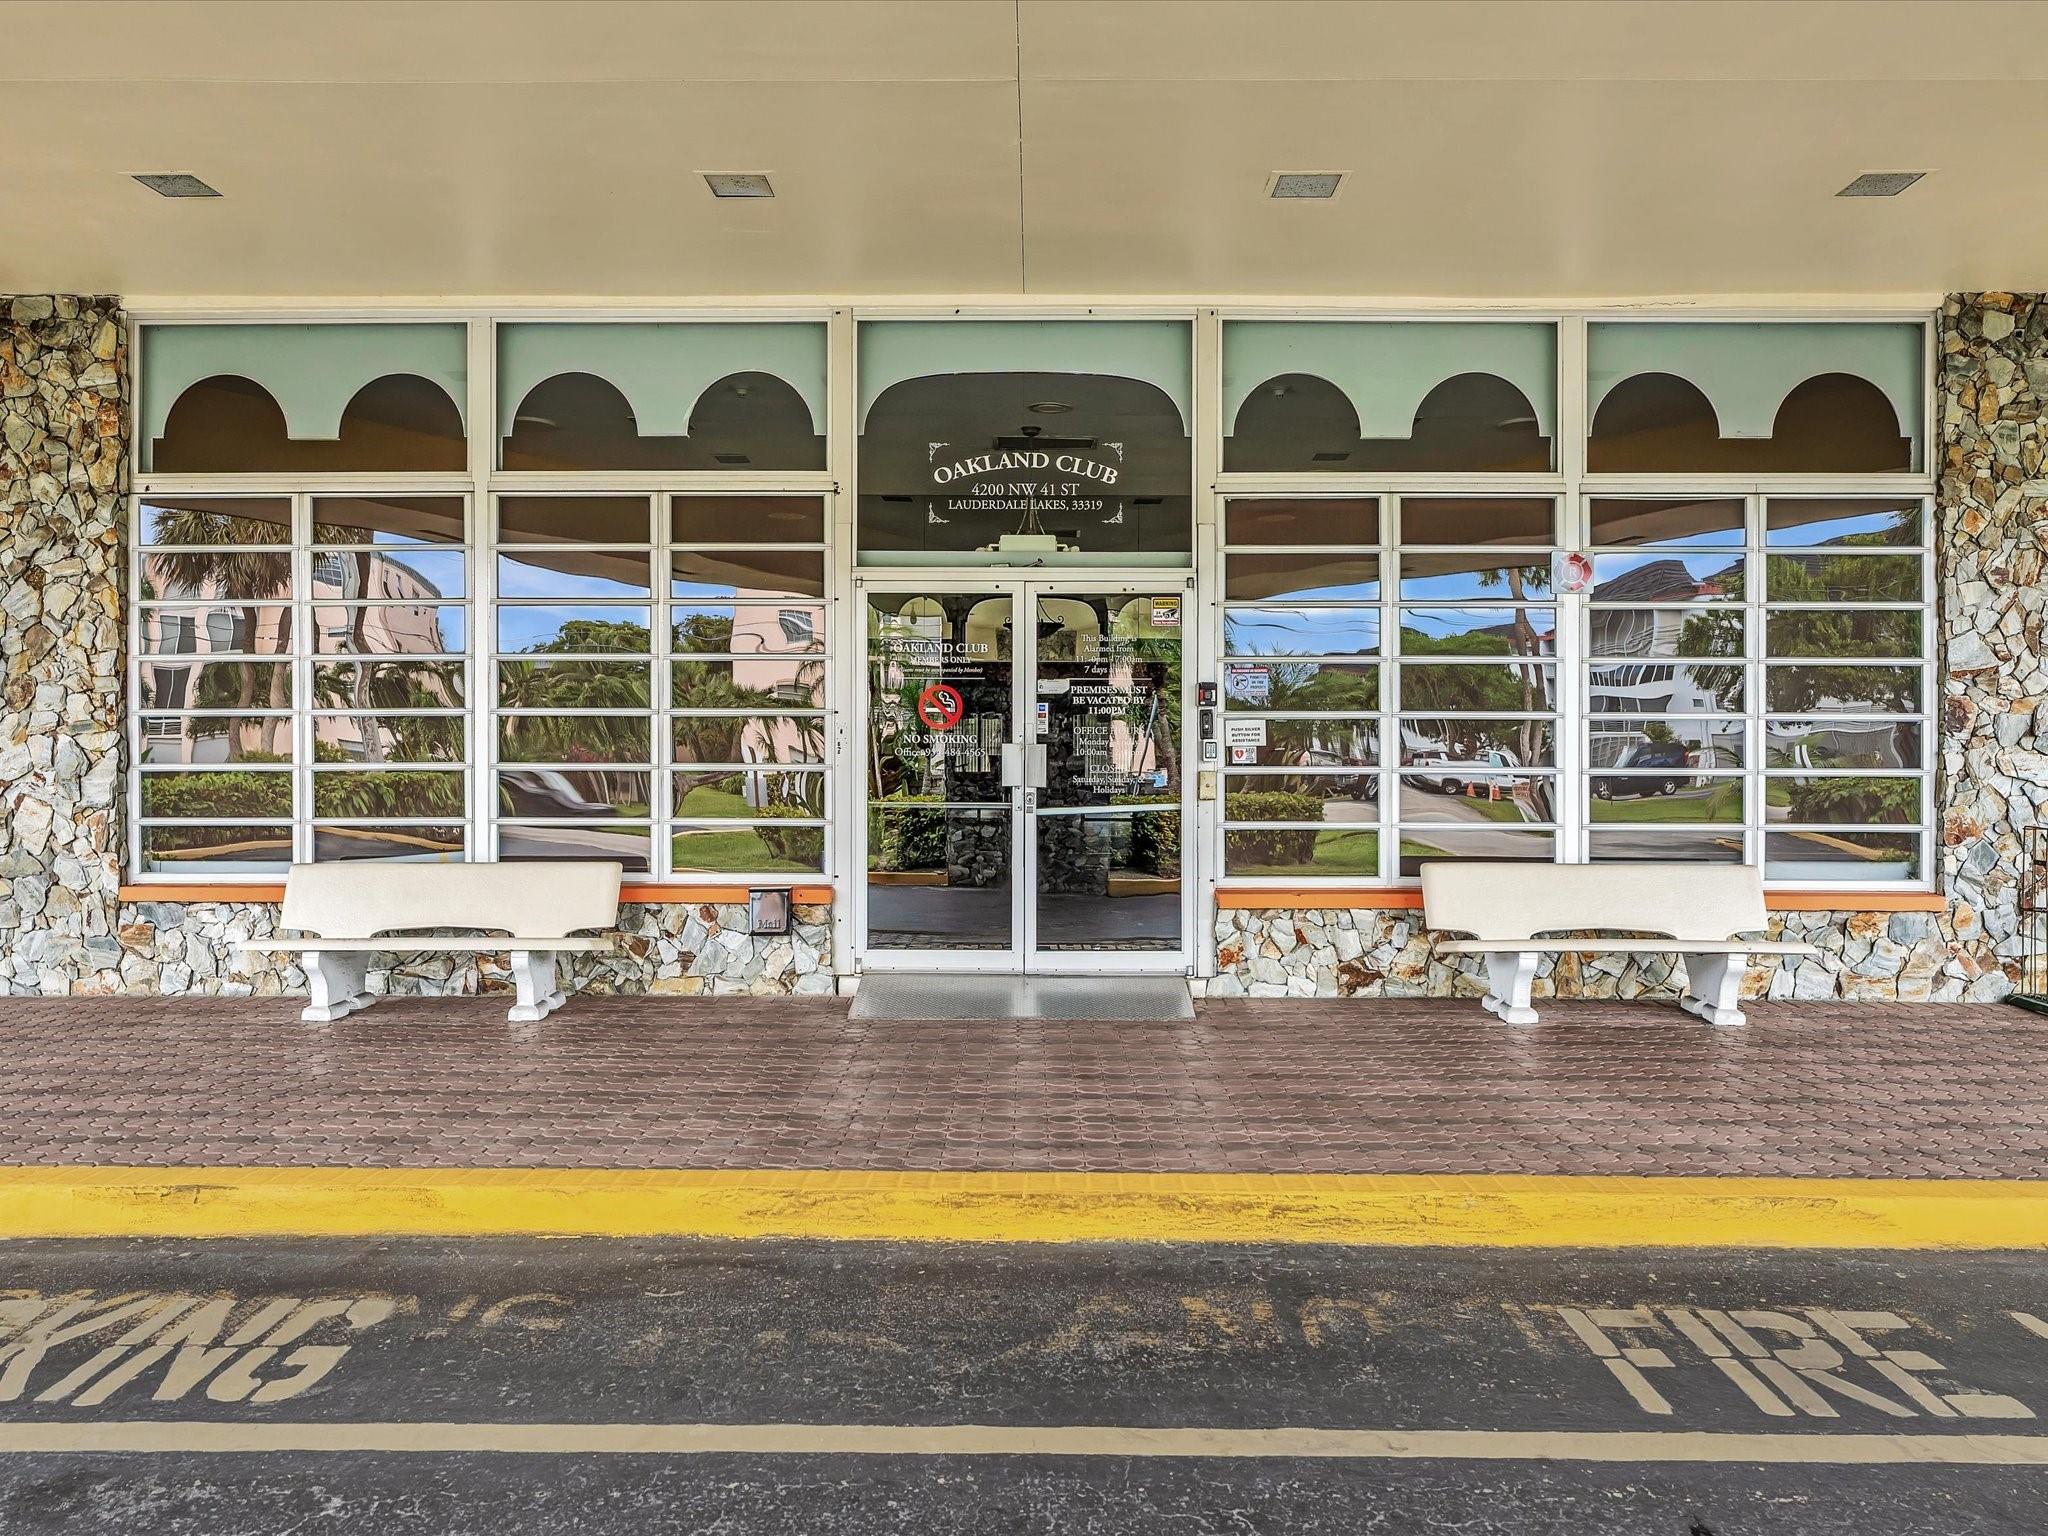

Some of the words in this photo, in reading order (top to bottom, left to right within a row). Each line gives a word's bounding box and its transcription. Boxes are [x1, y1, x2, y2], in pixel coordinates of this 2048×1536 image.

[933, 451, 1050, 484] OAKLAND
[1055, 455, 1119, 485] CLUB
[971, 482, 1004, 496] 4200
[1008, 482, 1037, 496] NW
[1040, 482, 1055, 496] 41
[1060, 482, 1080, 496] ST
[948, 499, 1027, 511] LAUDERDALE
[1030, 499, 1069, 512] LAKES,
[1071, 499, 1103, 511] 33319
[1081, 634, 1097, 642] This
[1098, 634, 1131, 645] Building
[893, 643, 954, 653] OAKLAND
[956, 643, 989, 653] CLUB
[1083, 645, 1115, 653] Alarmed
[1116, 645, 1134, 653] from
[909, 656, 949, 664] MEMBERS
[949, 656, 972, 664] ONLY
[1084, 665, 1090, 674] 7
[1091, 665, 1108, 676] days
[1071, 685, 1118, 694] PREMISES
[1119, 685, 1148, 694] MUST
[1072, 696, 1086, 705] BE
[1086, 696, 1131, 705] VACATED
[1133, 696, 1146, 705] BY
[1088, 706, 1126, 715] 11:00PM
[1073, 726, 1109, 735] OFFICE
[903, 734, 921, 744] NO
[922, 734, 978, 744] SMOKING
[1079, 737, 1110, 748] Monday
[1076, 748, 1107, 756] 10:00am
[1072, 775, 1106, 785] Saturday,
[1092, 786, 1126, 796] Holidays
[1554, 1304, 2037, 1419] FIRE
